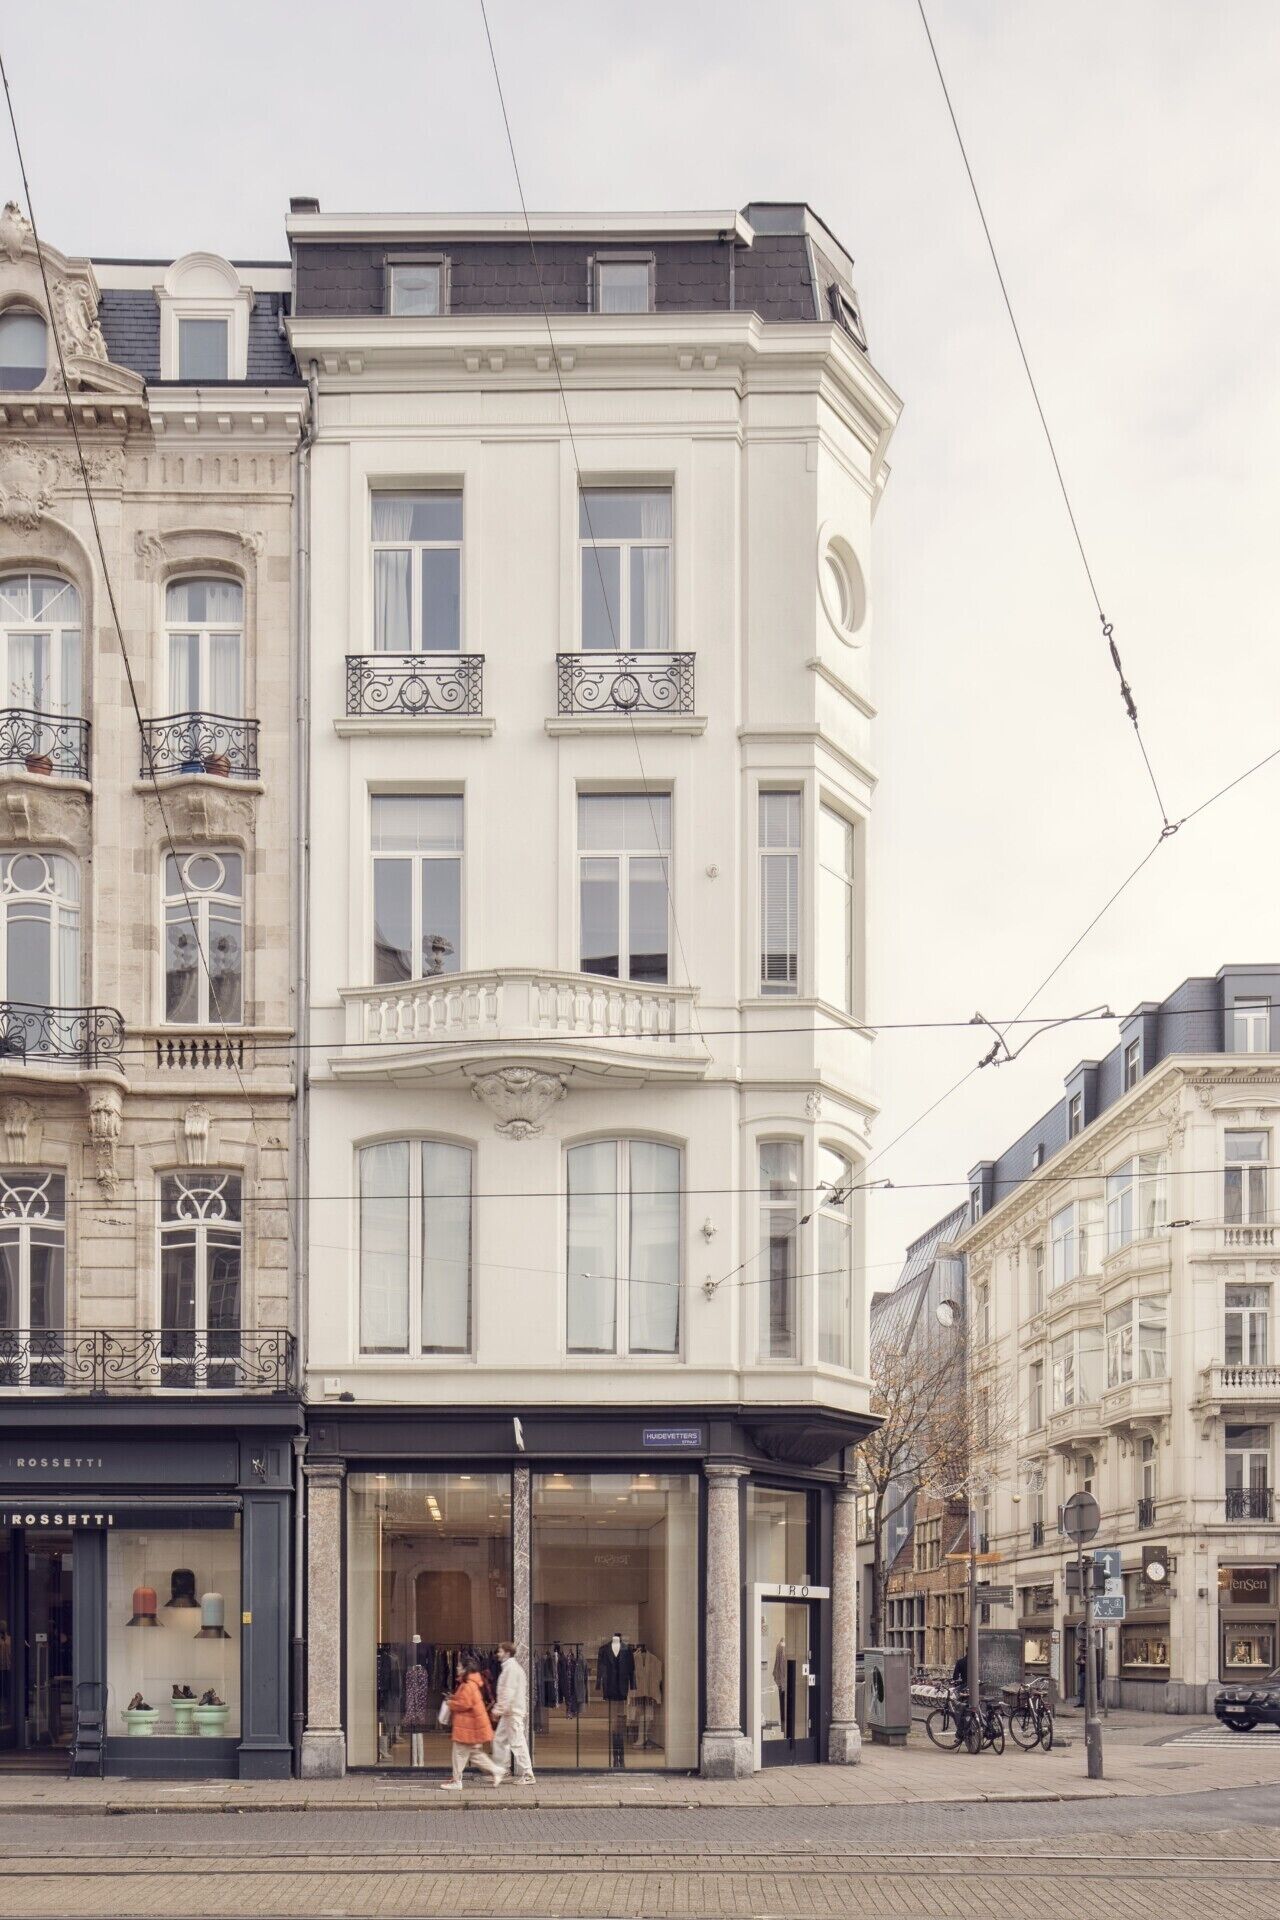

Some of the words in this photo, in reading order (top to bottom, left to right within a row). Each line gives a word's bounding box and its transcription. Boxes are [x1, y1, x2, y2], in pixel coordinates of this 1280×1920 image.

[17, 1458, 102, 1467] ROSSETTI
[12, 1514, 113, 1525] ROSSETTI
[778, 1584, 809, 1597] IRO
